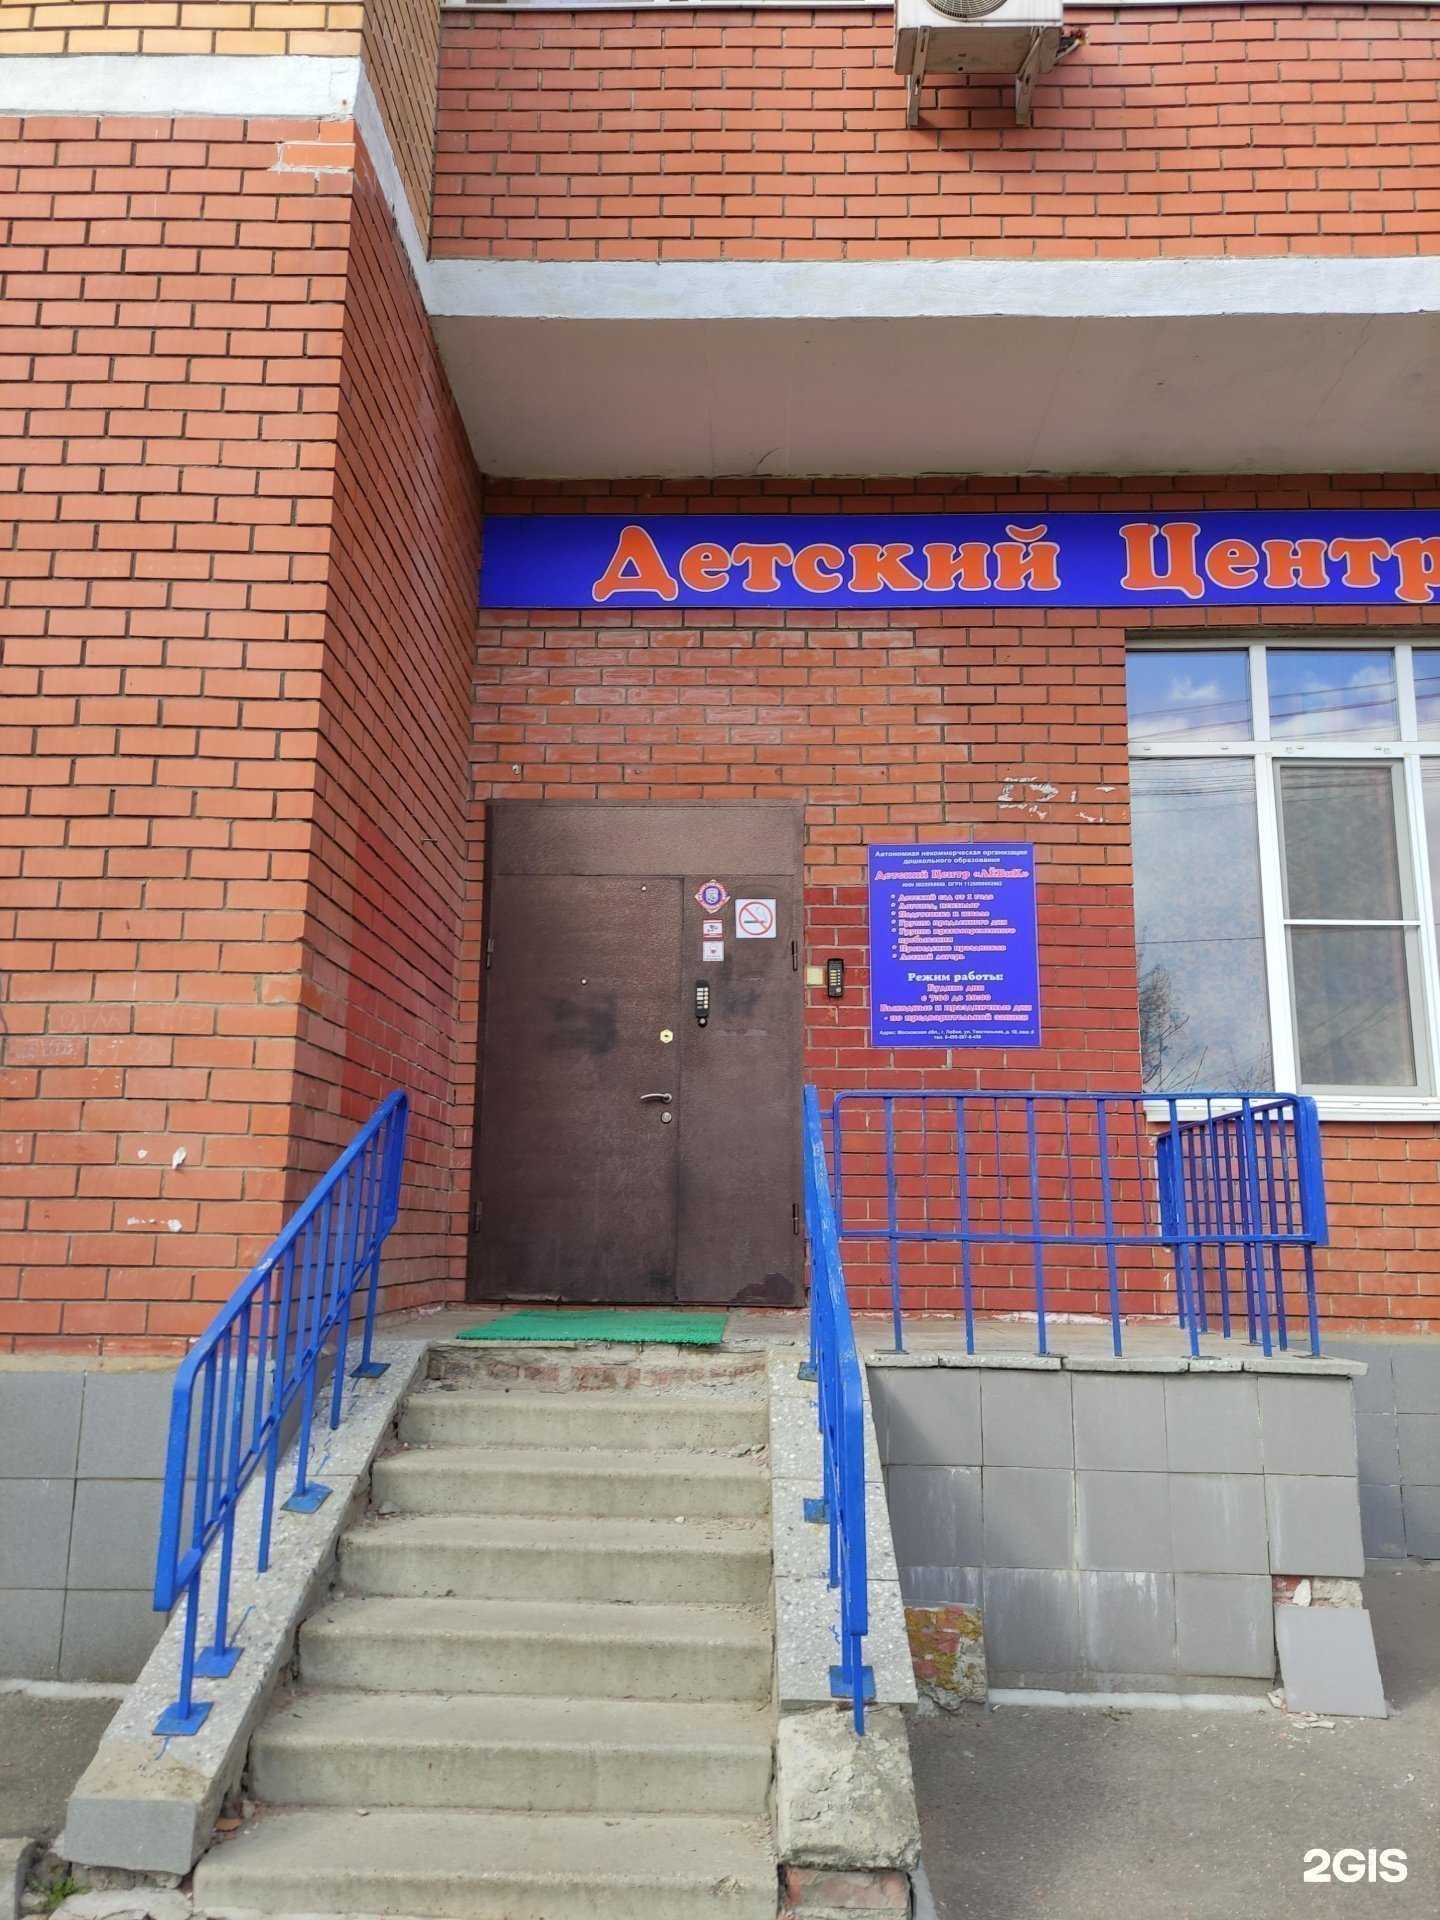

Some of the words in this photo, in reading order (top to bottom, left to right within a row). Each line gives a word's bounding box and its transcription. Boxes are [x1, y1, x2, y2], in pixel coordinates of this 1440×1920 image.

[592, 523, 1060, 602] Детский
[875, 870, 928, 881] Детский
[931, 869, 970, 881] Центр
[908, 972, 951, 982] Режим
[954, 971, 1003, 982] работы:
